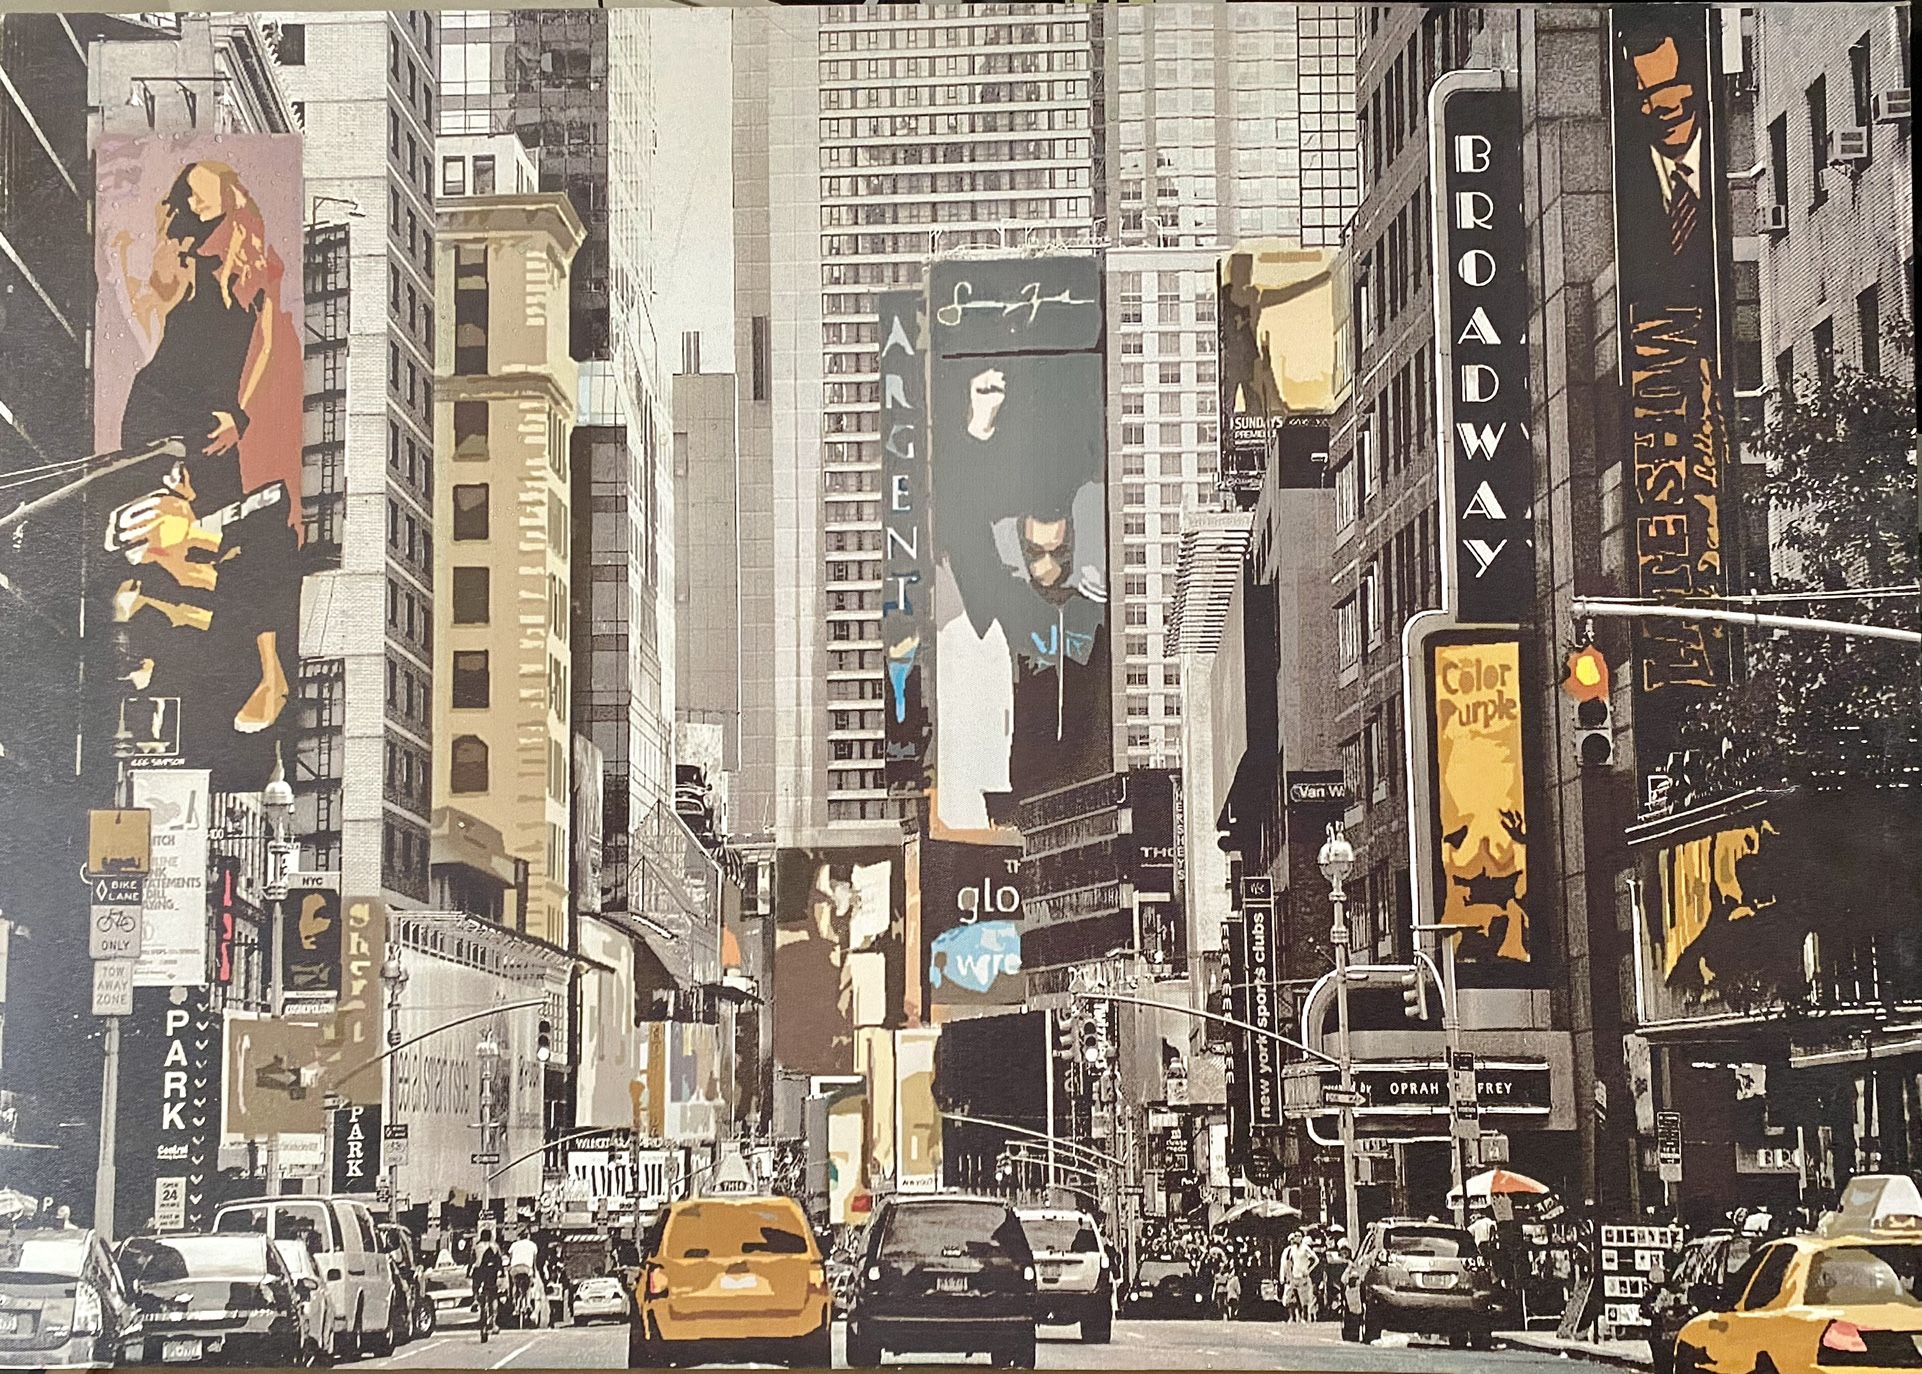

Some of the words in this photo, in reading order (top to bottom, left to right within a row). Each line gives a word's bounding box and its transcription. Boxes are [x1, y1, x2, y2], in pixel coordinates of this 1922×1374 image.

[1454, 134, 1507, 578] BROADWAY
[881, 314, 918, 611] ARGENT
[1442, 657, 1512, 695] Color
[1299, 785, 1325, 798] Van
[111, 880, 138, 890] BIKE
[302, 876, 324, 886] NYC
[108, 891, 140, 901] LANE
[1251, 911, 1266, 964] clubs
[101, 940, 130, 951] ONLY
[103, 966, 126, 976] TOW
[97, 980, 129, 991] AWAY
[96, 993, 129, 1005] ZONE
[1254, 966, 1271, 1028] sports
[1257, 1034, 1273, 1074] york
[161, 1009, 190, 1130] PARK
[1389, 1082, 1439, 1095] OPRAH
[1259, 1079, 1271, 1119] new
[345, 1106, 365, 1177] PARK
[162, 1189, 178, 1200] 24
